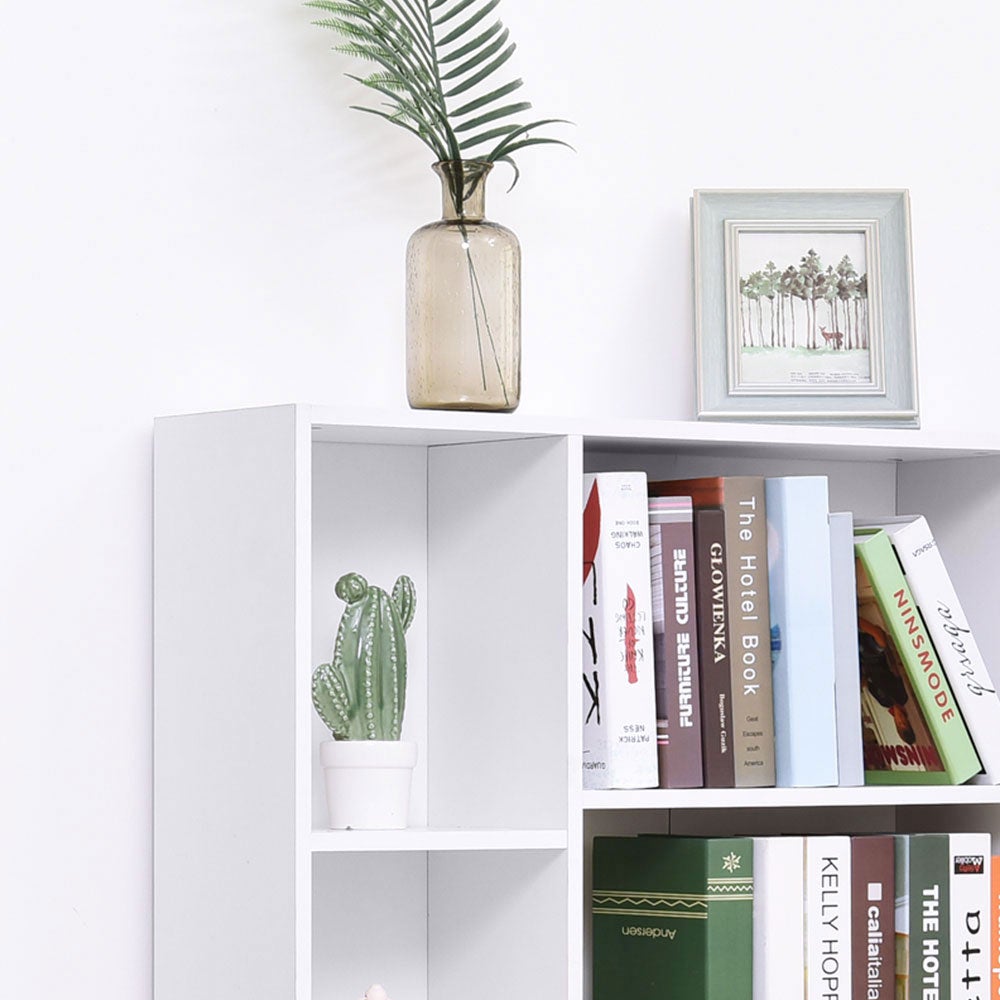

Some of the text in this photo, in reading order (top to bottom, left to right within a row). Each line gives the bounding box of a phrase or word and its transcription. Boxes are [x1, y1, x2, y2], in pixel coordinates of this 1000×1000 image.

[614, 540, 641, 549] CHAOS
[673, 548, 691, 625] CULTURE
[739, 496, 760, 696] The Hotel Book
[893, 588, 955, 723] NINSMODE
[618, 734, 650, 743] PATRICK
[623, 724, 645, 732] NESS
[821, 856, 839, 931] KELLY
[922, 884, 940, 932] THE
[621, 926, 677, 940] Andersen
